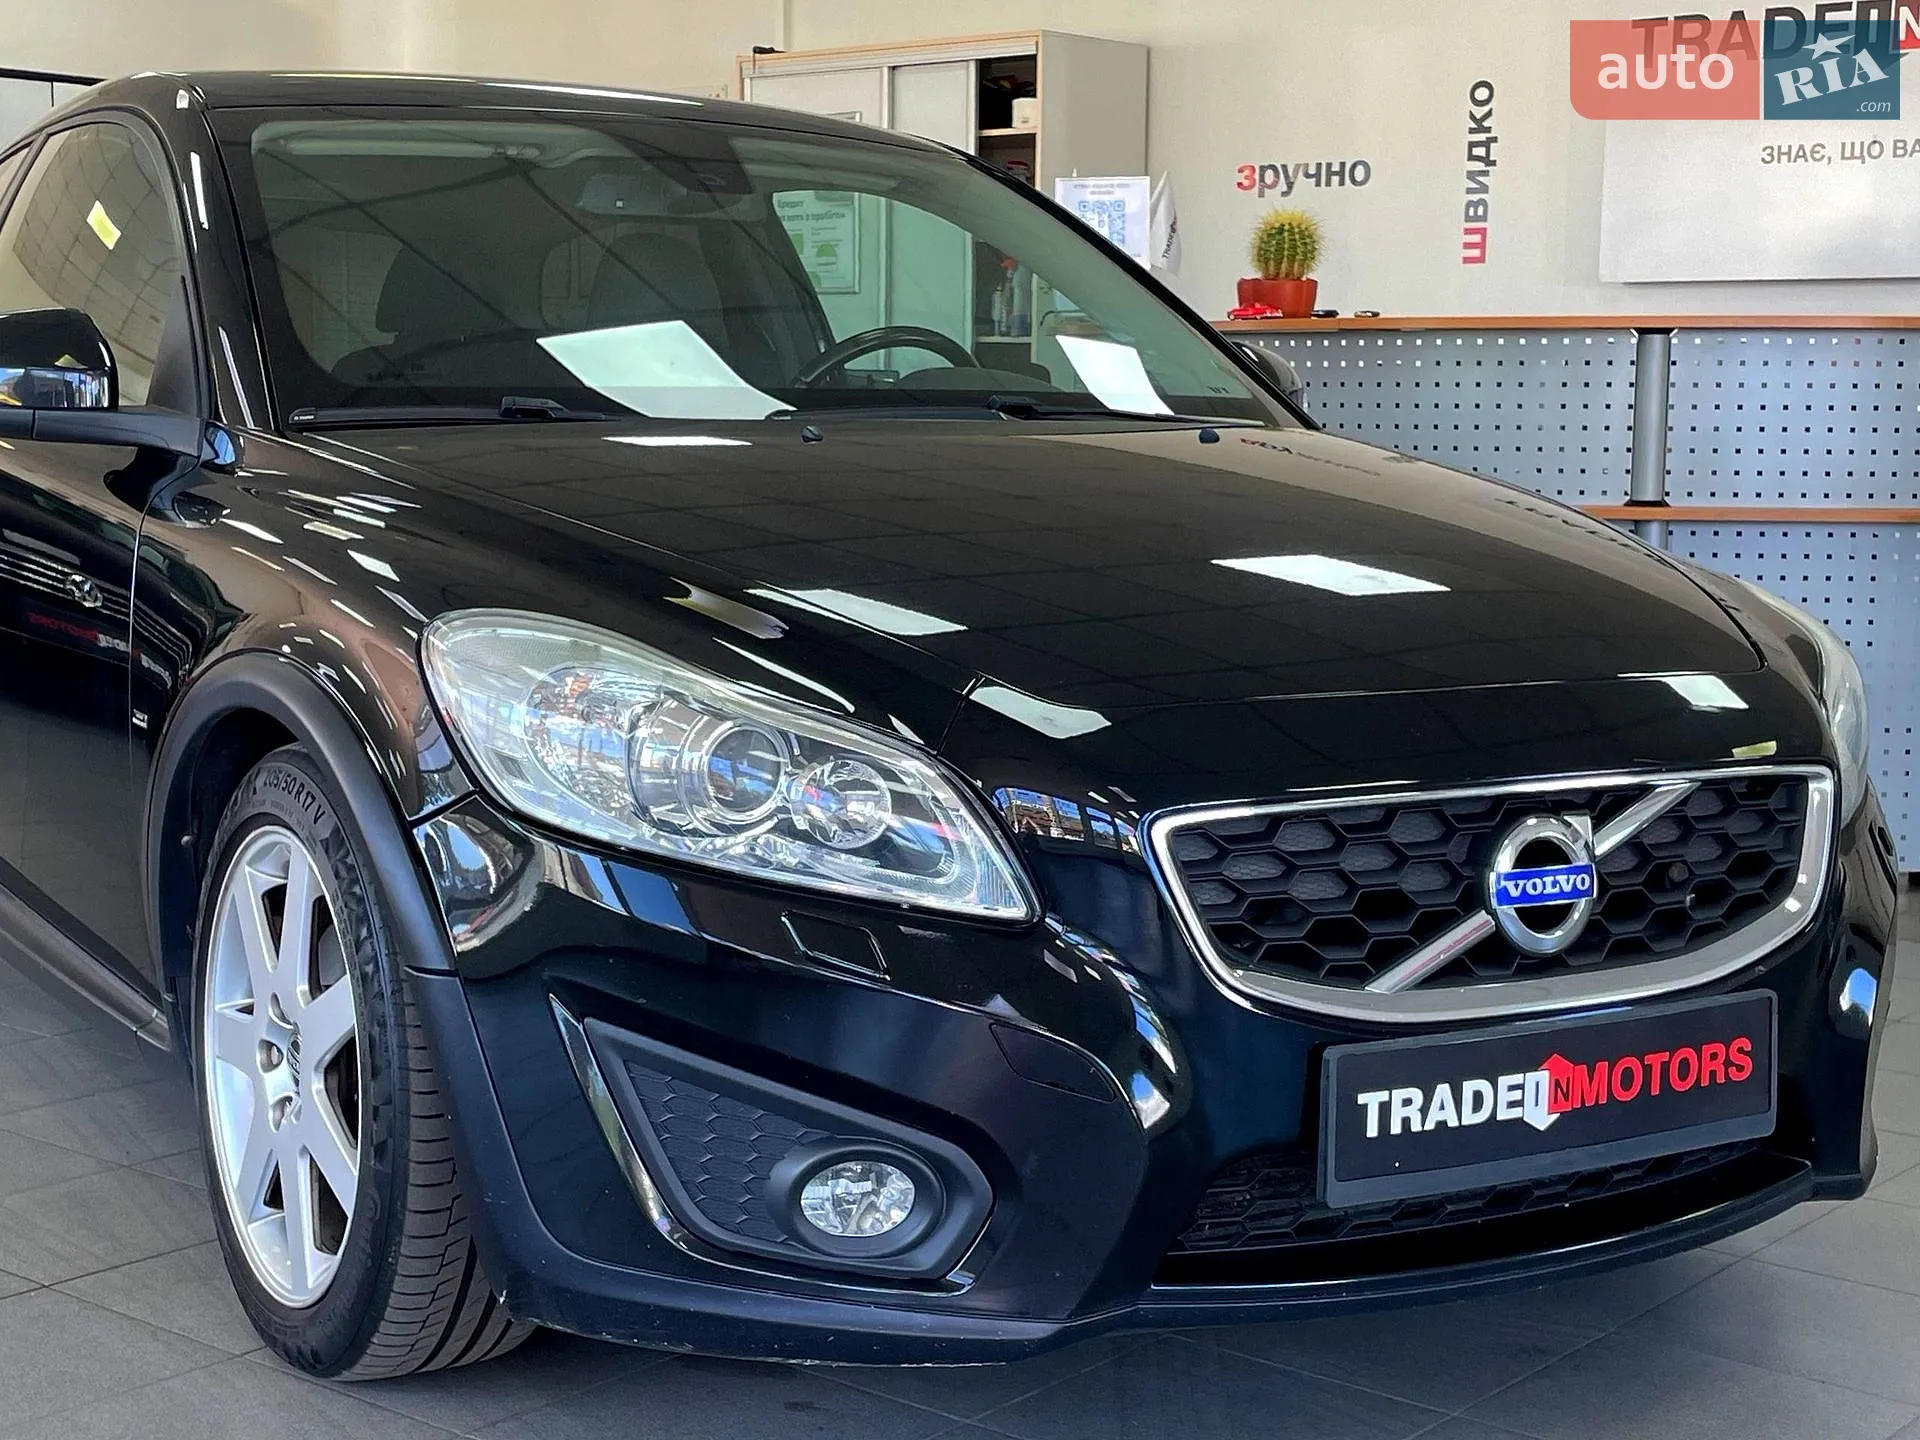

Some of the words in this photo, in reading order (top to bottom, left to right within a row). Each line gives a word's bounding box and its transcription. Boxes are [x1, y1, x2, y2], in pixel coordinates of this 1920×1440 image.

[1760, 142, 1832, 166] ЗНАЄ,
[1840, 137, 1885, 165] ЩО
[1892, 138, 1920, 159] ВА
[1236, 159, 1371, 198] зручно
[1503, 873, 1591, 898] VOLVO
